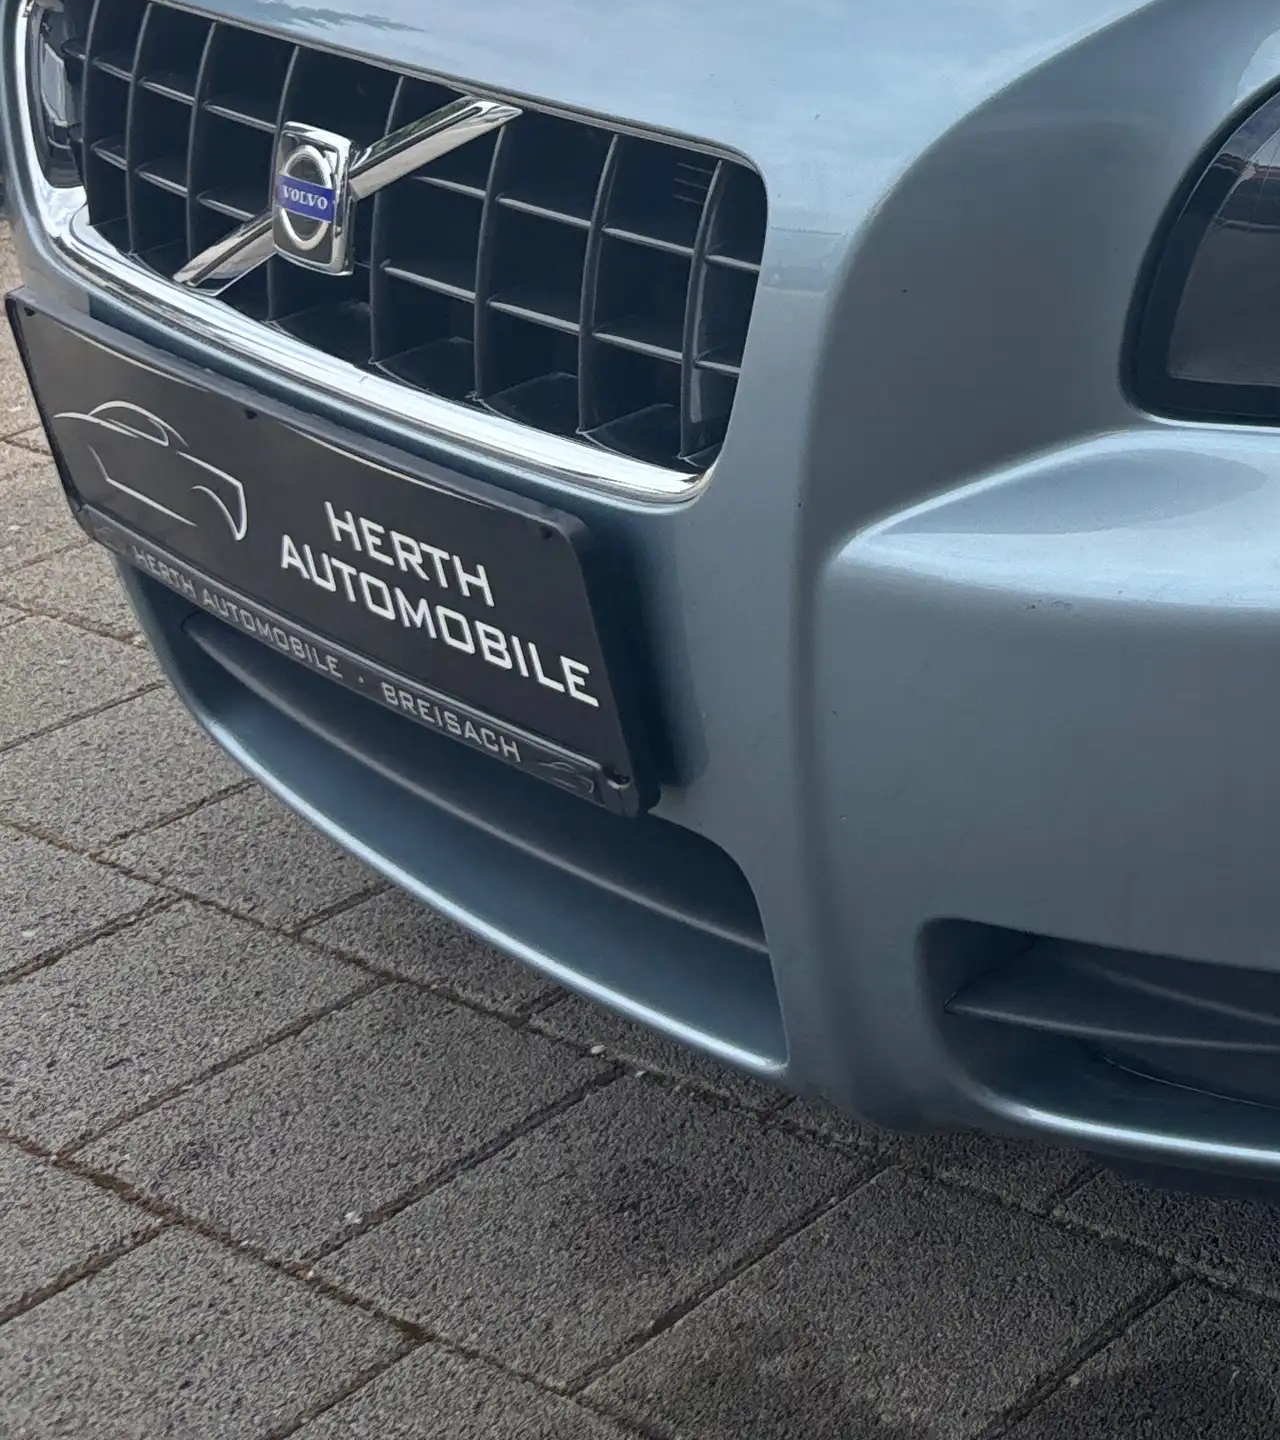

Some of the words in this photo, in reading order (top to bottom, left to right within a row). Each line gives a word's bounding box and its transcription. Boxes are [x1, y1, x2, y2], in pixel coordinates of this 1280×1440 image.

[282, 185, 328, 210] VOLVO
[280, 534, 600, 707] AUTOMOBILE
[325, 501, 495, 607] HERTH
[132, 544, 195, 600] HERTH
[202, 589, 344, 680] AUTOMOBILE
[382, 684, 522, 763] BREISACH
